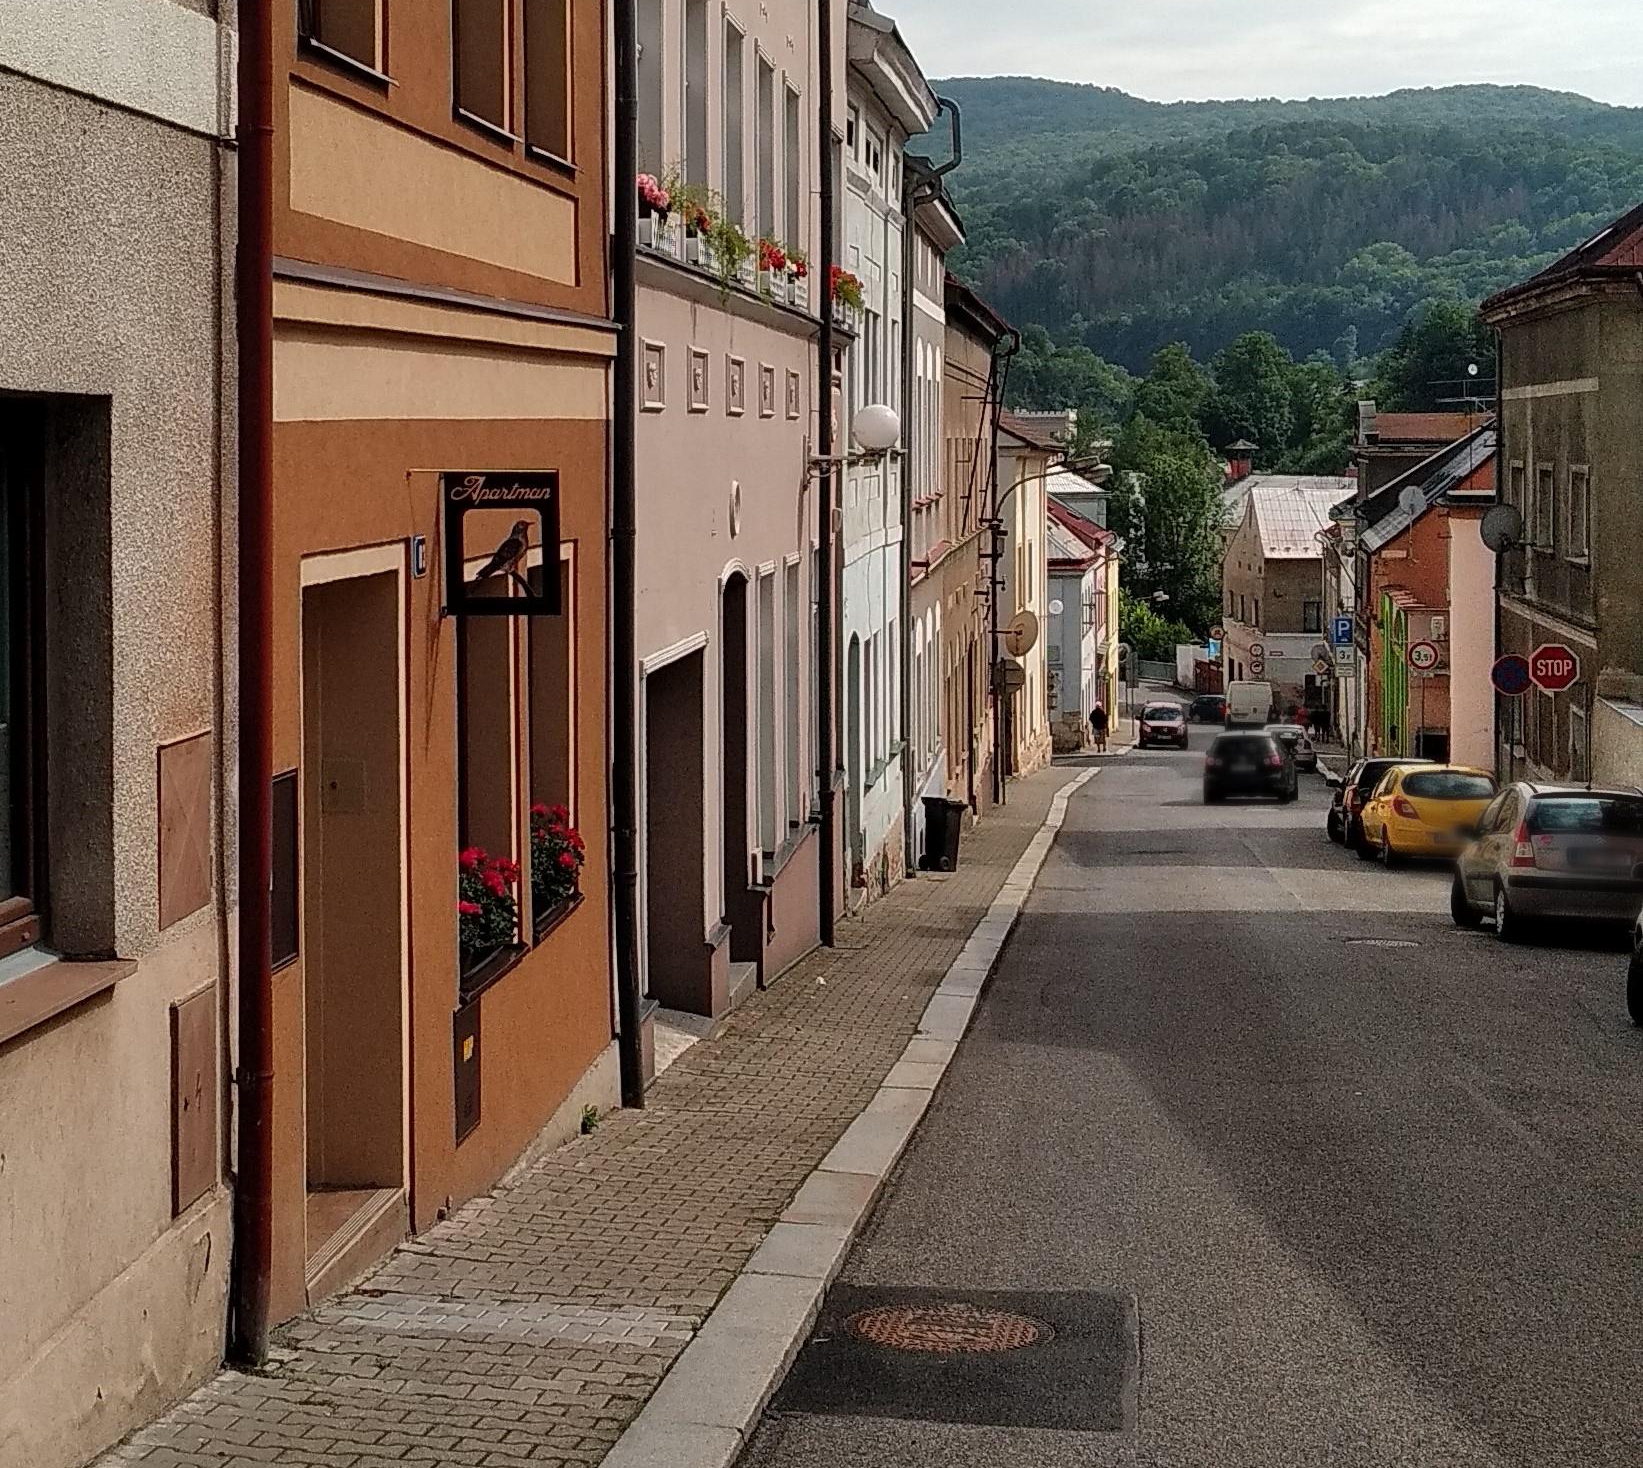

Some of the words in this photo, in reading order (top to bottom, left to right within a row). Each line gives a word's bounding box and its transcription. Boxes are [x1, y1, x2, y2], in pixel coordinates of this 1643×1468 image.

[450, 475, 551, 506] Apartman
[1338, 620, 1350, 637] P
[1536, 659, 1573, 677] STOP
